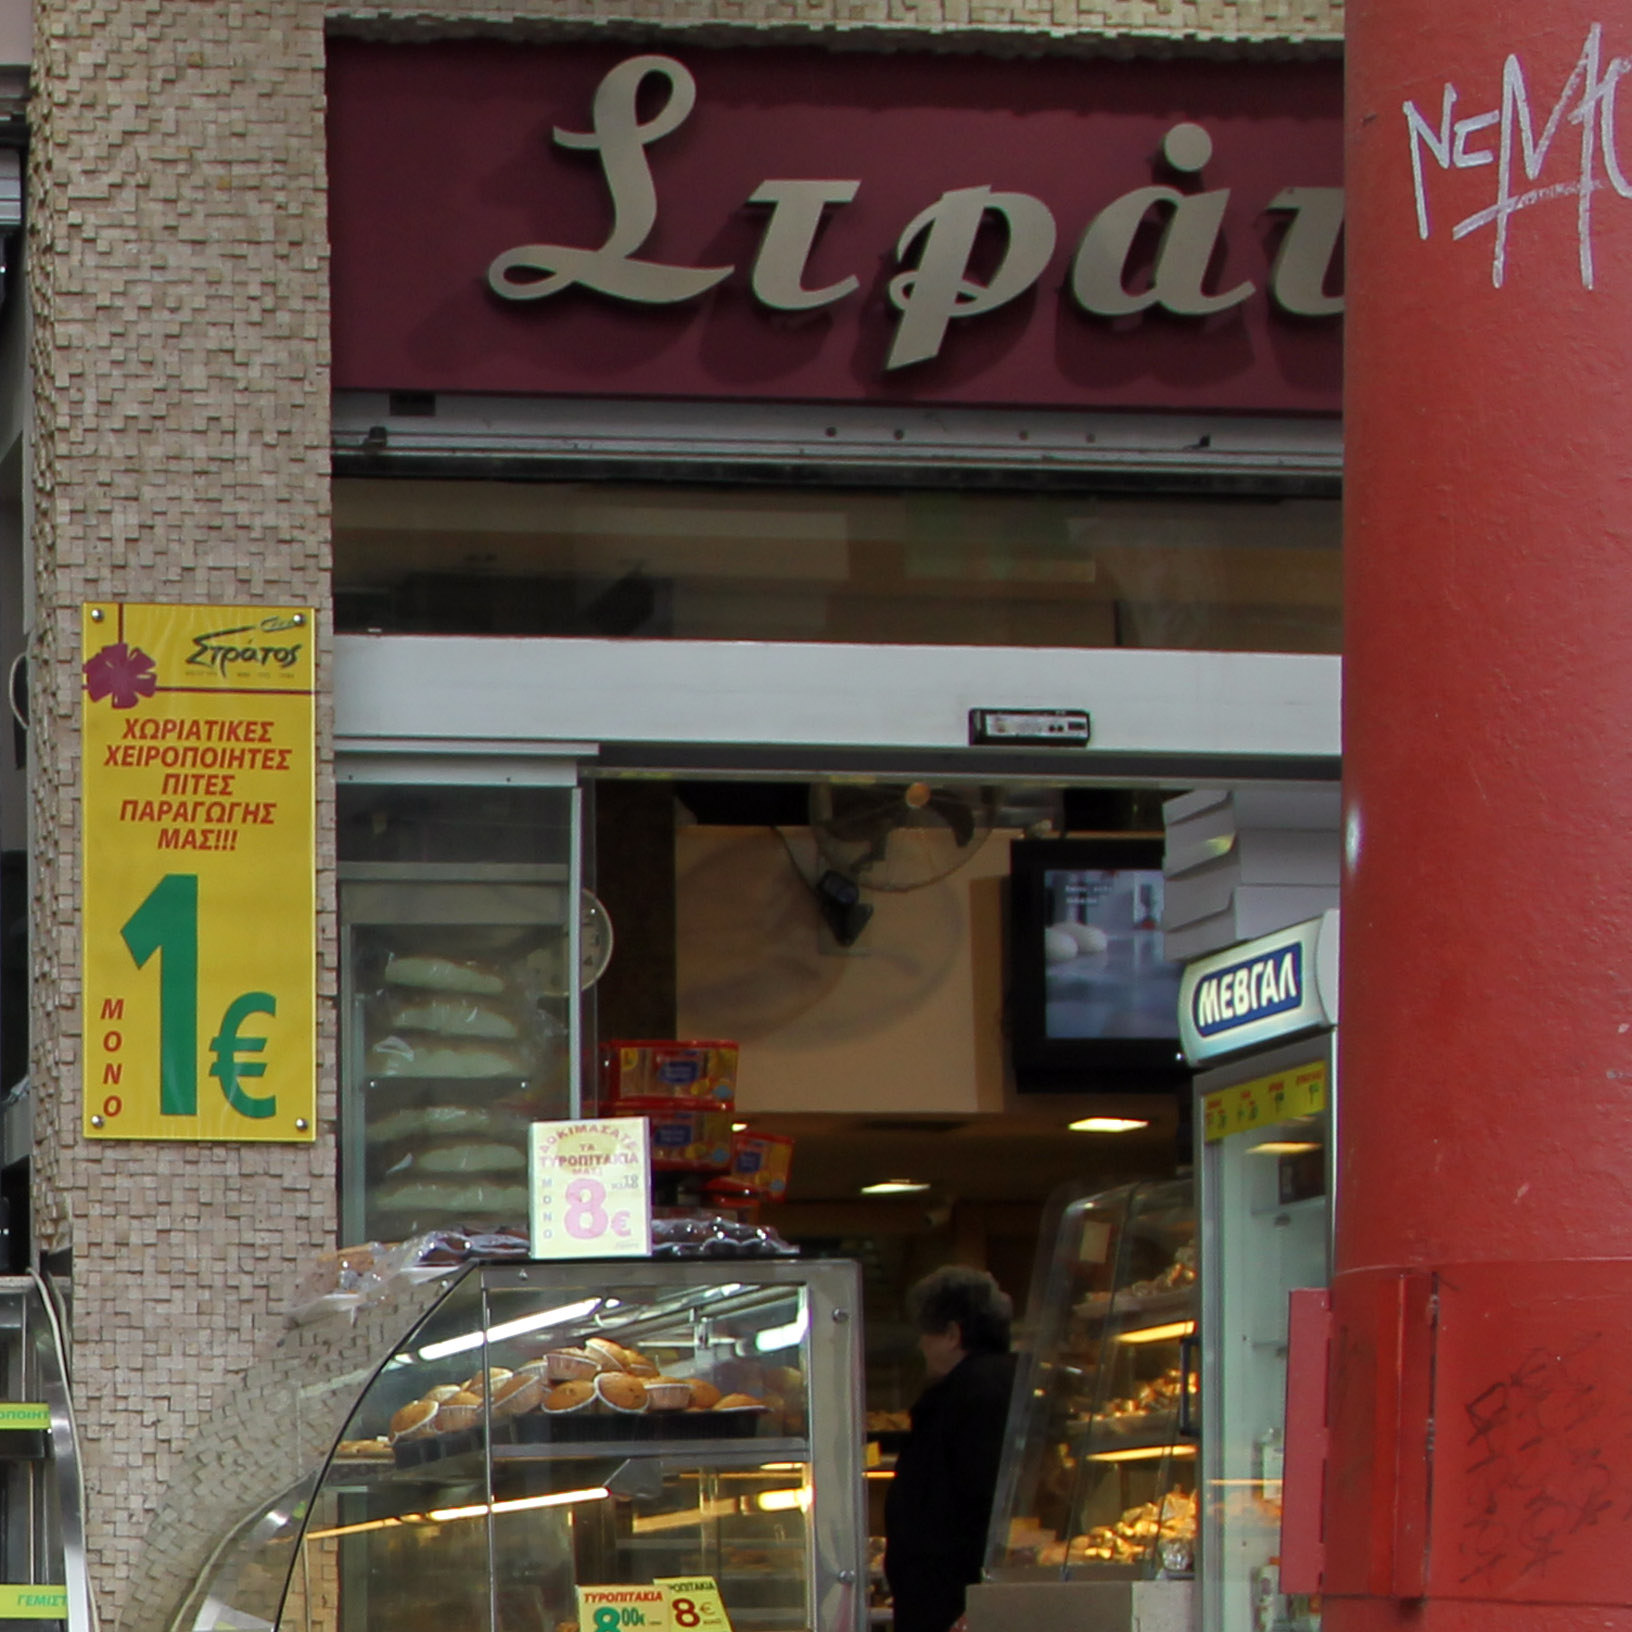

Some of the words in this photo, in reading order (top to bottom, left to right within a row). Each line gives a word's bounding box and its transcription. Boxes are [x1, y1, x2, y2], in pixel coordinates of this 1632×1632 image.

[122, 718, 274, 743] ΧΩΡΙΑΤΙΚΕΣ
[104, 745, 292, 771] ΧΕΙΡΟΠΟΙΗΤΕΣ
[162, 773, 236, 796] ΠΙΤΕΣ
[120, 800, 277, 825] ΠΑΡΑΓΩΓΗΣ
[157, 829, 239, 851] ΜΑΣ!!!
[1199, 952, 1297, 1027] ΜΕΒΓΑΛ
[100, 998, 124, 1118] ΜΟΝΟ
[539, 1153, 638, 1167] ΤΥΡΟΠΙΤΑΚΙΑ
[584, 1591, 663, 1604] ΤΥΡΟΠΙΤΑΚΙΑ
